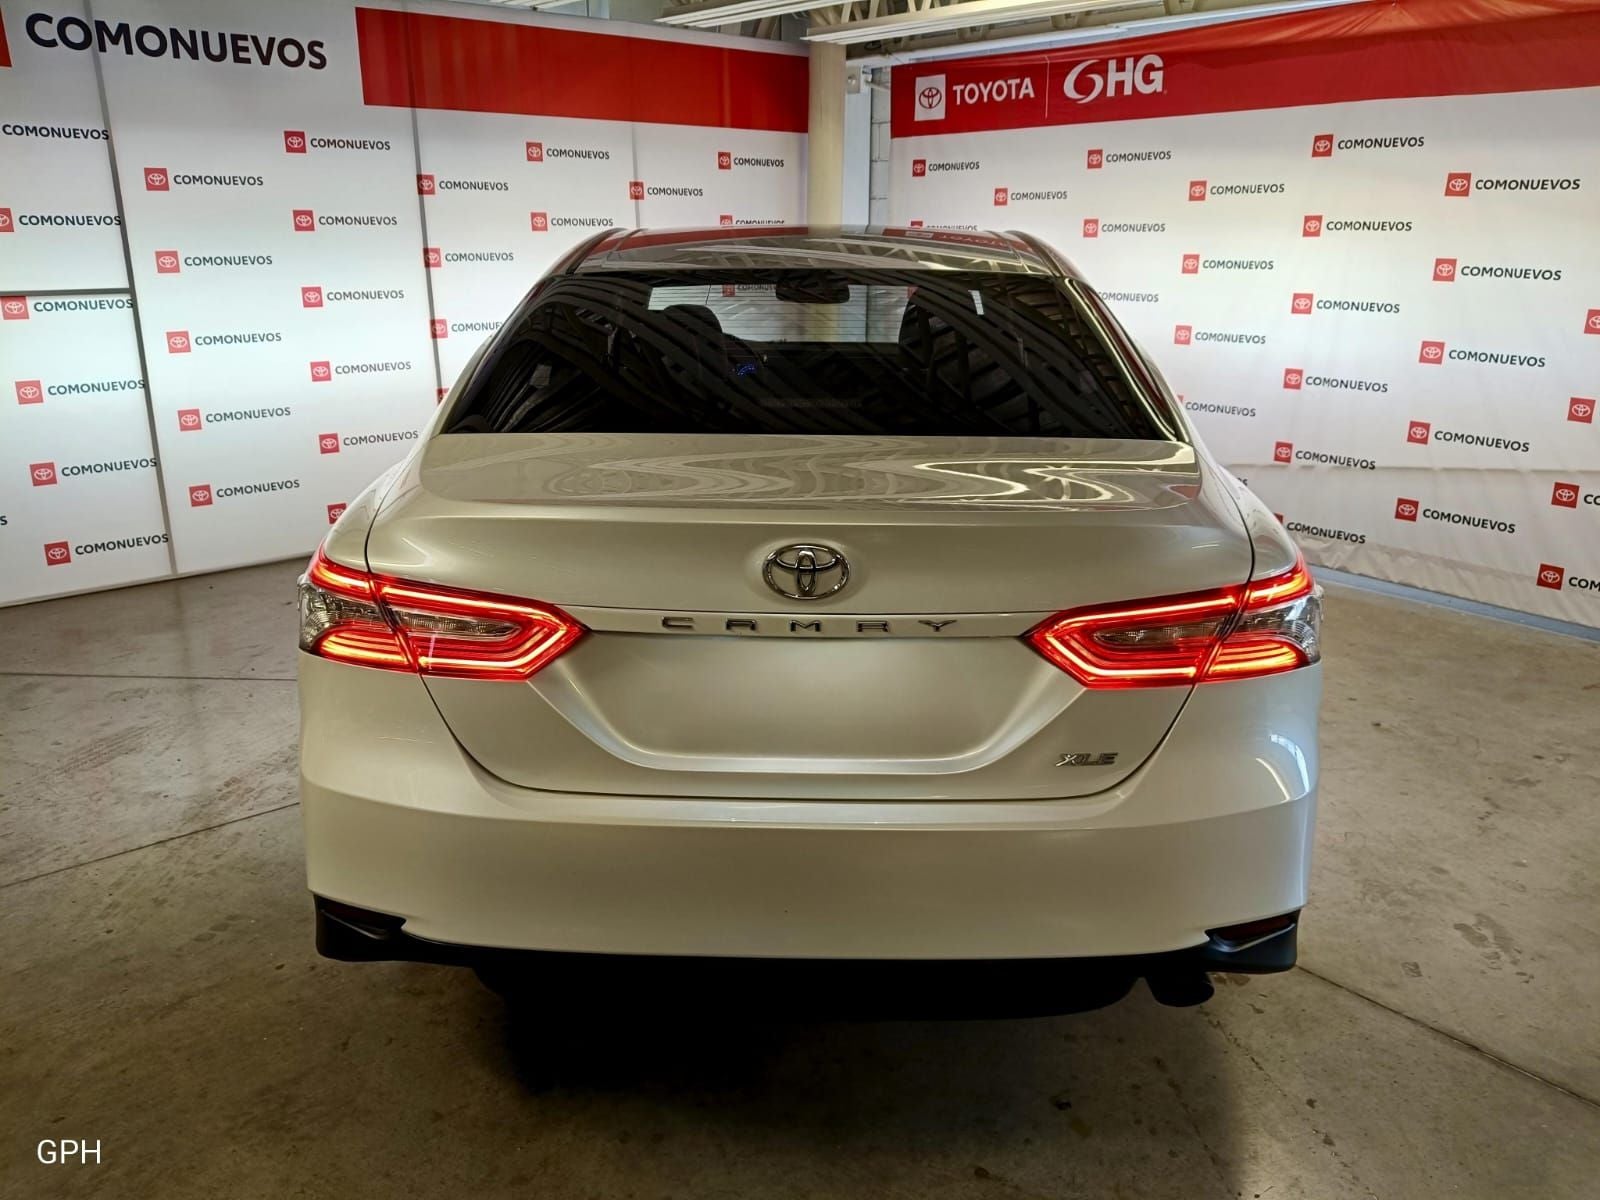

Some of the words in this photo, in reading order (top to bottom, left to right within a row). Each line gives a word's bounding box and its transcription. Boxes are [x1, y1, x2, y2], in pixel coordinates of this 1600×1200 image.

[25, 13, 327, 70] COMONUEVOS
[953, 77, 1035, 105] TOYOTA
[2, 123, 109, 141] COMONUEVOS
[310, 138, 391, 151] COMONUEVOS
[1337, 136, 1425, 150] COMONUEVOS
[546, 148, 610, 160] COMONUEVOS
[1106, 150, 1171, 163] COMONUEVOS
[733, 157, 784, 167] COMONUEVOS
[928, 161, 980, 171] COMONUEVOS
[173, 174, 264, 186] COMONUEVOS
[438, 180, 509, 191] COMONUEVOS
[1475, 179, 1581, 190] COMONUEVOS
[647, 186, 703, 197] COMONUEVOS
[1011, 190, 1067, 201] COMONUEVOS
[1210, 184, 1285, 195] COMONUEVOS
[19, 215, 121, 226] COMONUEVOS
[318, 216, 398, 226] COMONUEVOS
[550, 216, 614, 227] COMONUEVOS
[1102, 223, 1165, 232] COMONUEVOS
[1326, 221, 1412, 232] COMONUEVOS
[184, 255, 273, 267] COMONUEVOS
[445, 251, 514, 262] COMONUEVOS
[1202, 260, 1274, 270] COMONUEVOS
[1460, 265, 1562, 281] COMONUEVOS
[327, 290, 405, 301] COMONUEVOS
[1099, 292, 1159, 303] OMONUEVOS
[33, 298, 134, 313] COMONUEVOS
[1316, 300, 1400, 314] COMONUEVOS
[451, 322, 502, 332] COMONUE
[195, 332, 282, 347] COMONUEVOS
[1195, 332, 1266, 344] COMONUEVOS
[1448, 350, 1546, 368] COMONUEVOS
[335, 361, 412, 376] COMONUEVOS
[47, 379, 146, 397] COMONUEVOS
[1305, 376, 1388, 393] COMONUEVOS
[205, 407, 292, 424] COMONUEVOS
[1185, 401, 1256, 417] COMONUEVOS
[343, 430, 419, 447] COMONUEVOS
[1434, 430, 1530, 453] COMONUEVOS
[1295, 450, 1376, 470] COMONUEVOS
[61, 457, 157, 478] COMONUEVOS
[216, 479, 300, 499] COMONUEVOS
[1423, 508, 1516, 534] COMONUEVOS
[1287, 522, 1366, 544] COMONUEVOS
[75, 533, 169, 556] COMONUEVOS
[662, 616, 957, 632] CAMRY
[1055, 752, 1118, 767] XLE
